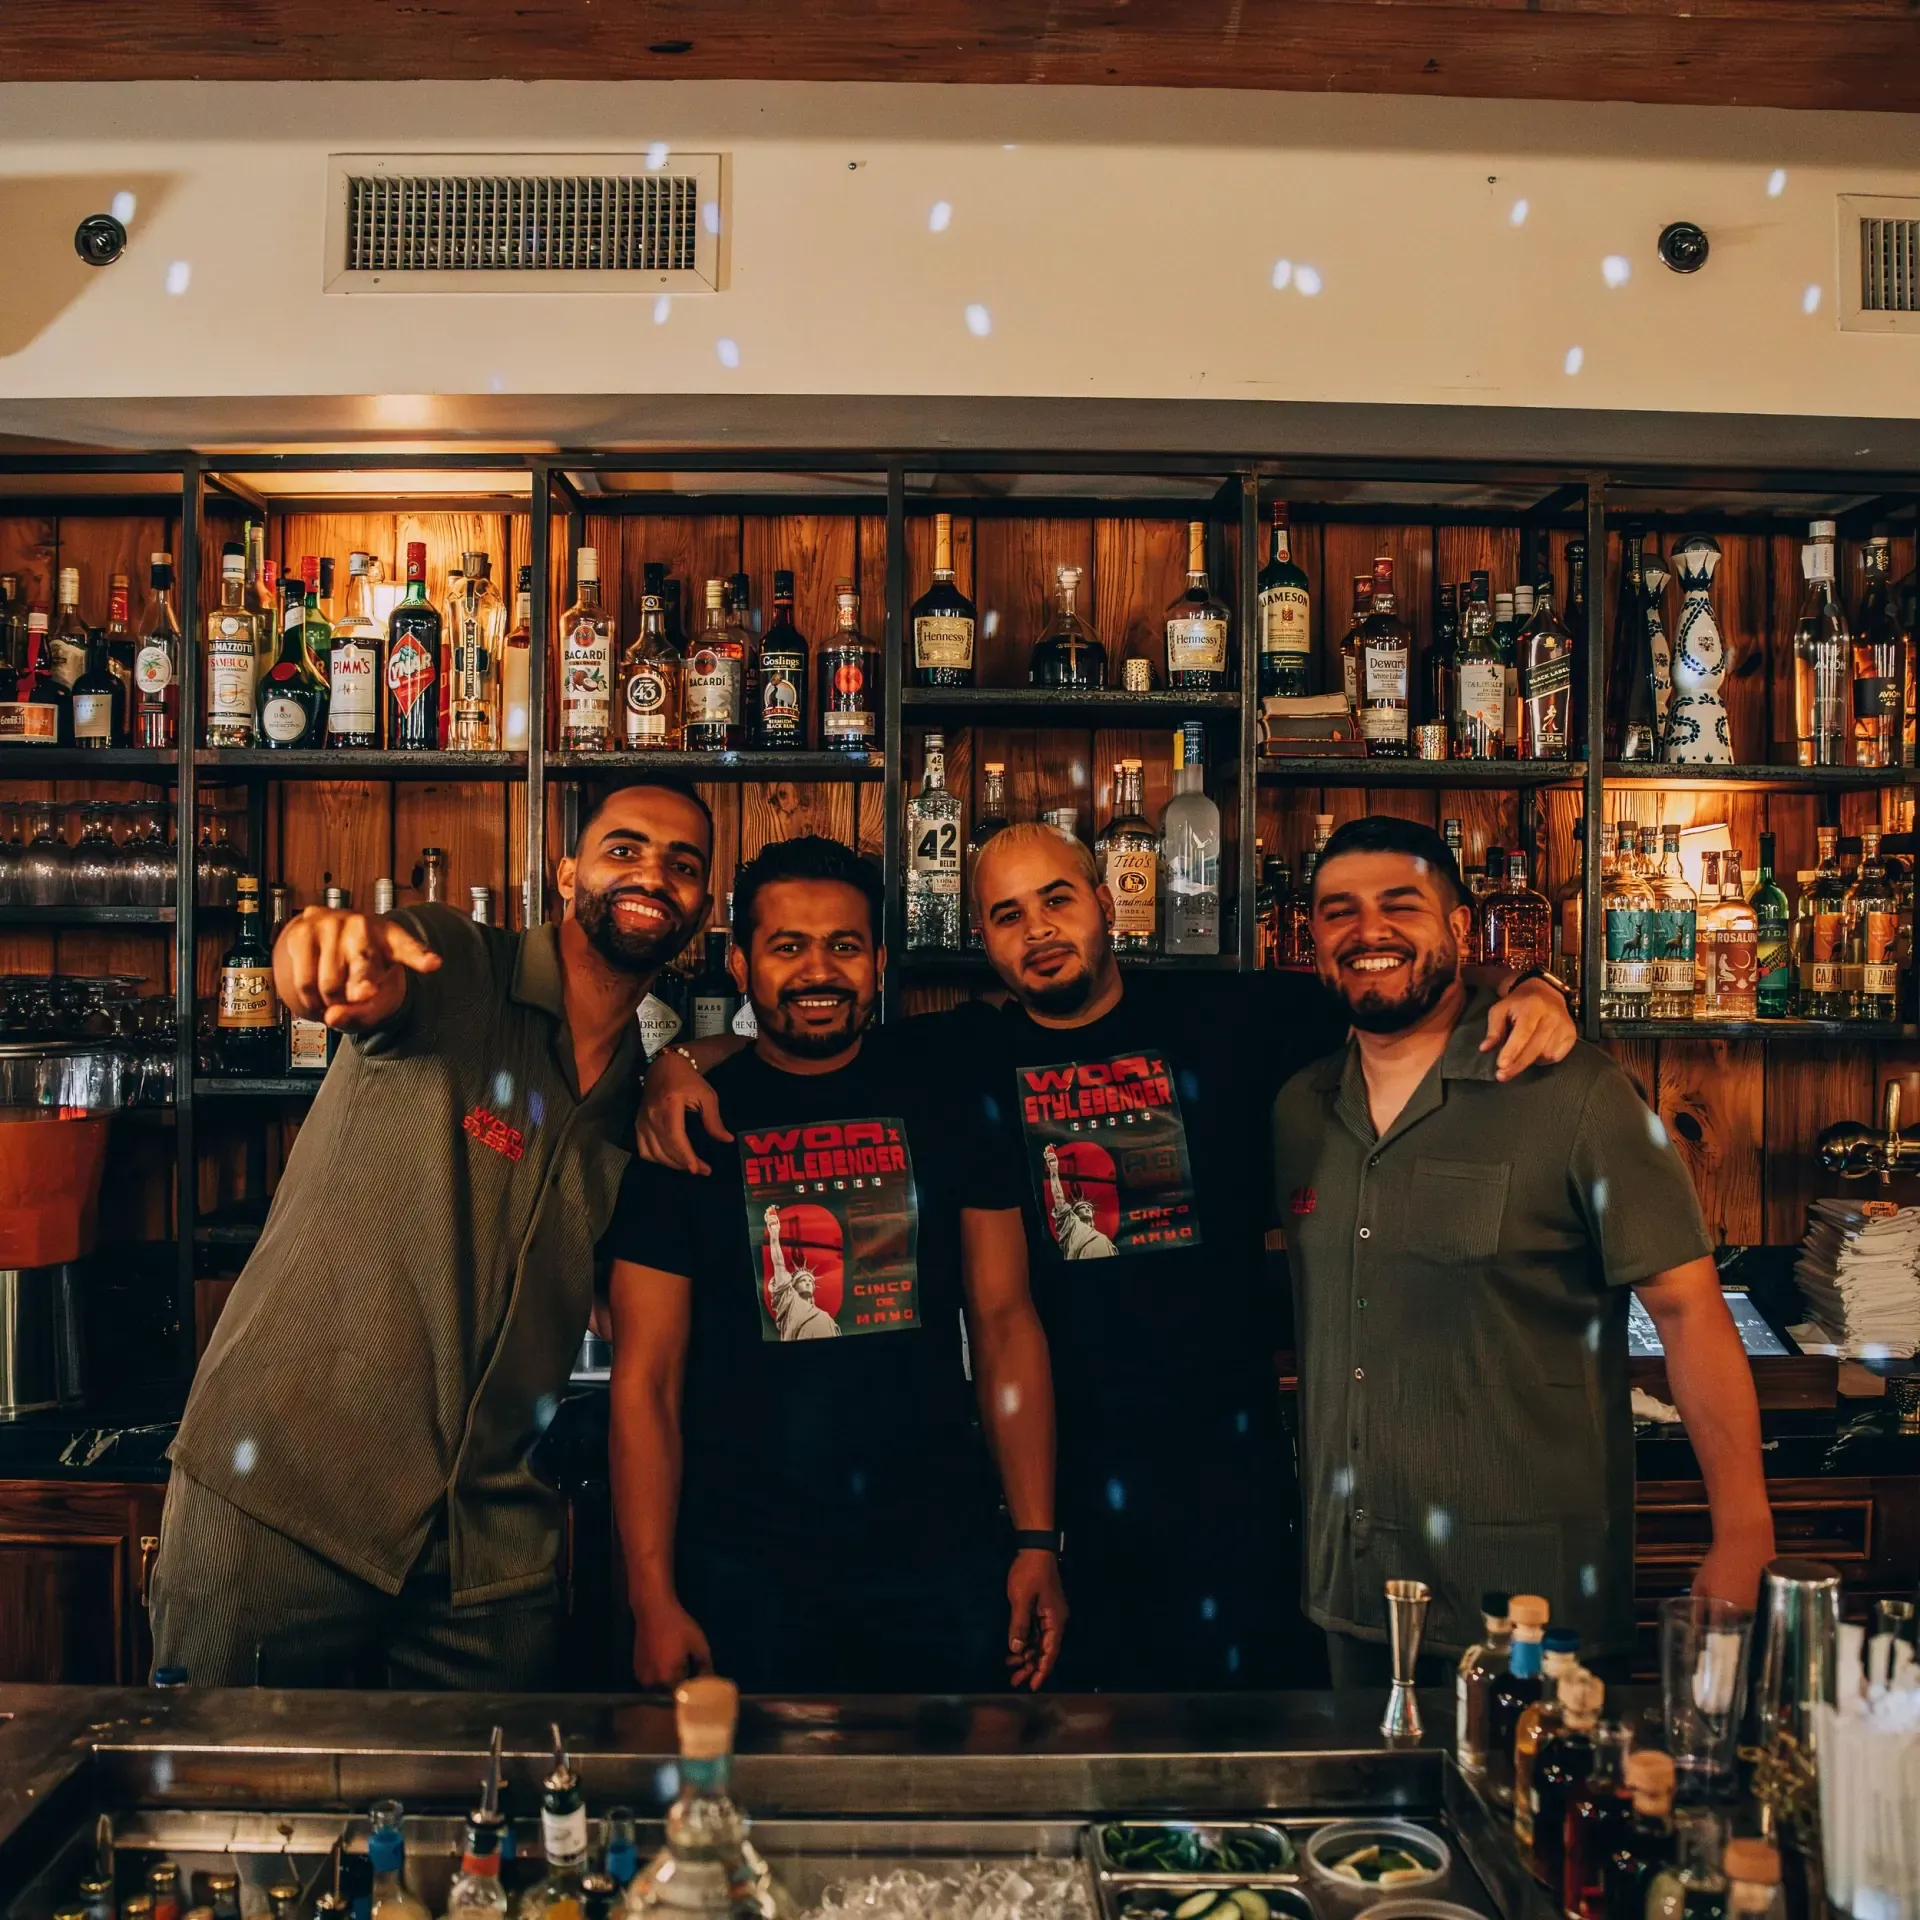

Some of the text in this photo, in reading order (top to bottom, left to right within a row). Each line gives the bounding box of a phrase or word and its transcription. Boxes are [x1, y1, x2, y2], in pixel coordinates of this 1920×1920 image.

[1261, 592, 1308, 608] JAMESON
[923, 631, 966, 644] Hennessy
[1176, 634, 1218, 647] Hennessy
[564, 648, 607, 661] BACARDÍ
[762, 655, 800, 669] Goslings
[210, 658, 249, 669] SAMBUCA
[333, 658, 371, 675] PIMM'S
[689, 675, 727, 687] BACARDÍ
[1528, 673, 1549, 685] BLACK
[1550, 667, 1571, 677] LABEL
[632, 683, 657, 701] 43
[1545, 735, 1555, 743] 12
[931, 754, 942, 765] 42
[917, 822, 957, 861] 42
[939, 859, 957, 868] BELOW
[1113, 853, 1152, 869] Tito's
[1115, 895, 1155, 907] andmade
[1716, 932, 1758, 943] ROSALUN
[1607, 967, 1652, 985] CAZADORE
[697, 1004, 722, 1012] MASS
[640, 1020, 678, 1029] DRICK'S
[1024, 1056, 1148, 1092] WOA
[1024, 1076, 1172, 1123] STYLEBENDER
[744, 1122, 884, 1154] WOA
[745, 1145, 906, 1185] STYLEBENDER
[853, 1280, 912, 1296] CINCO
[856, 1308, 913, 1325] MAYO
